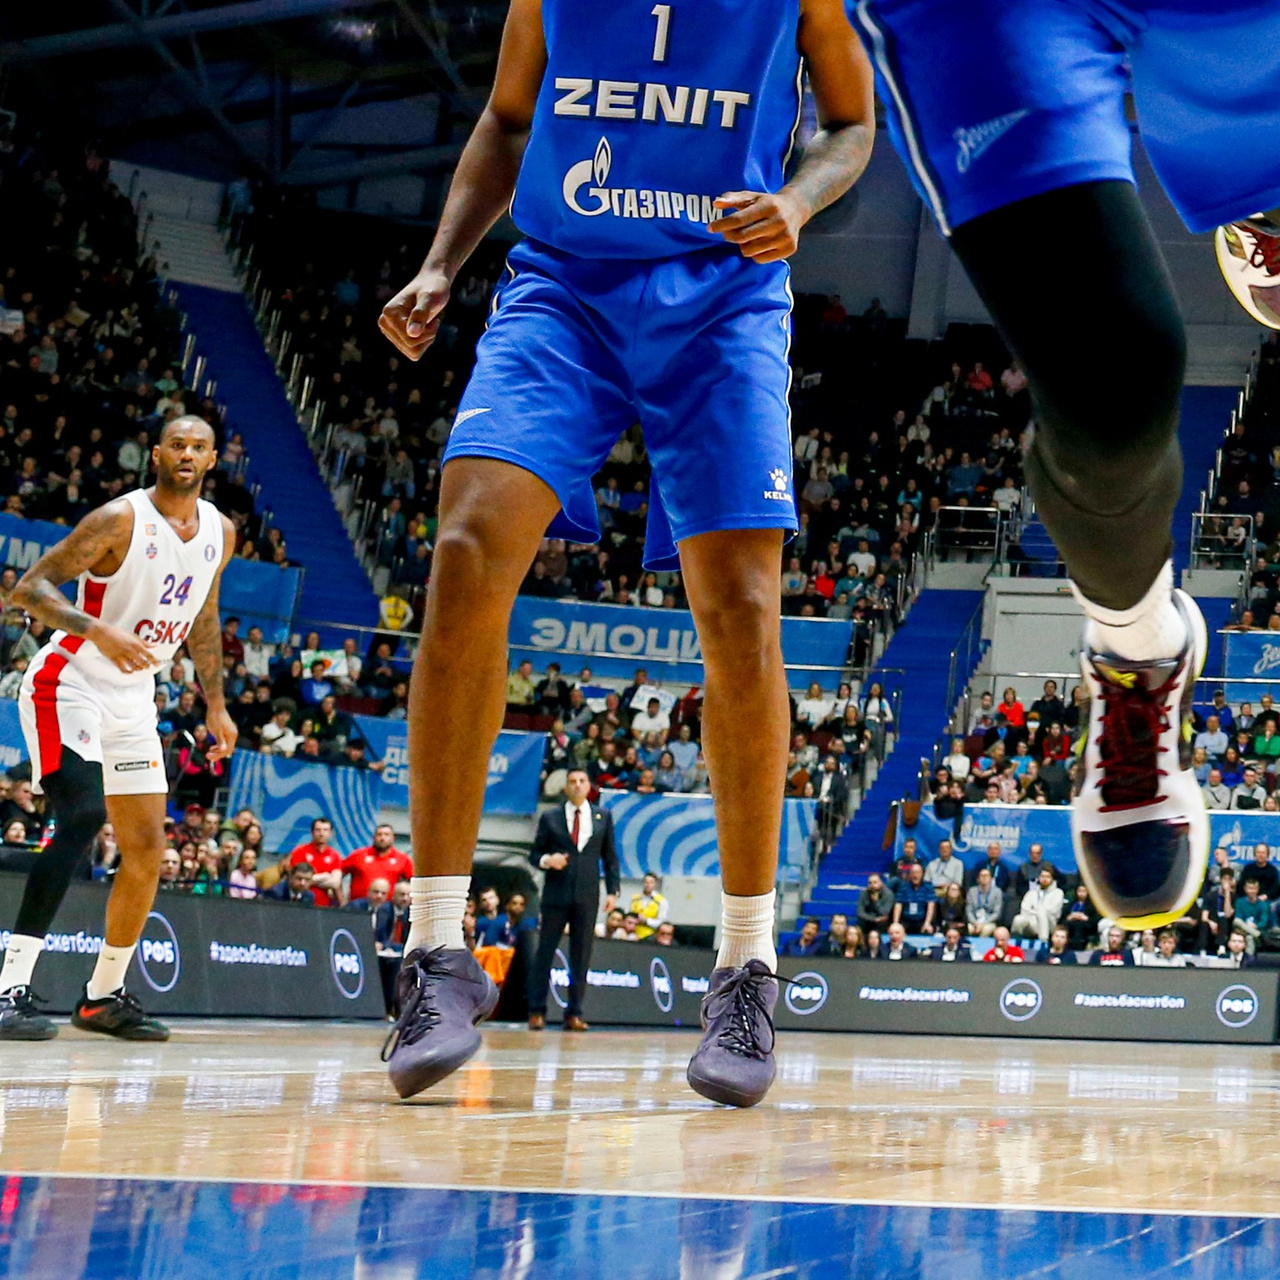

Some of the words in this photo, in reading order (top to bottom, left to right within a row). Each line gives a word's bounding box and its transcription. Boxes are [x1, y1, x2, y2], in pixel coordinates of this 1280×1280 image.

[651, 4, 671, 62] 1
[554, 77, 750, 128] ZENIT
[763, 491, 793, 503] KELM
[159, 573, 193, 606] 24
[134, 619, 190, 645] CSKA
[142, 939, 175, 964] РФБ
